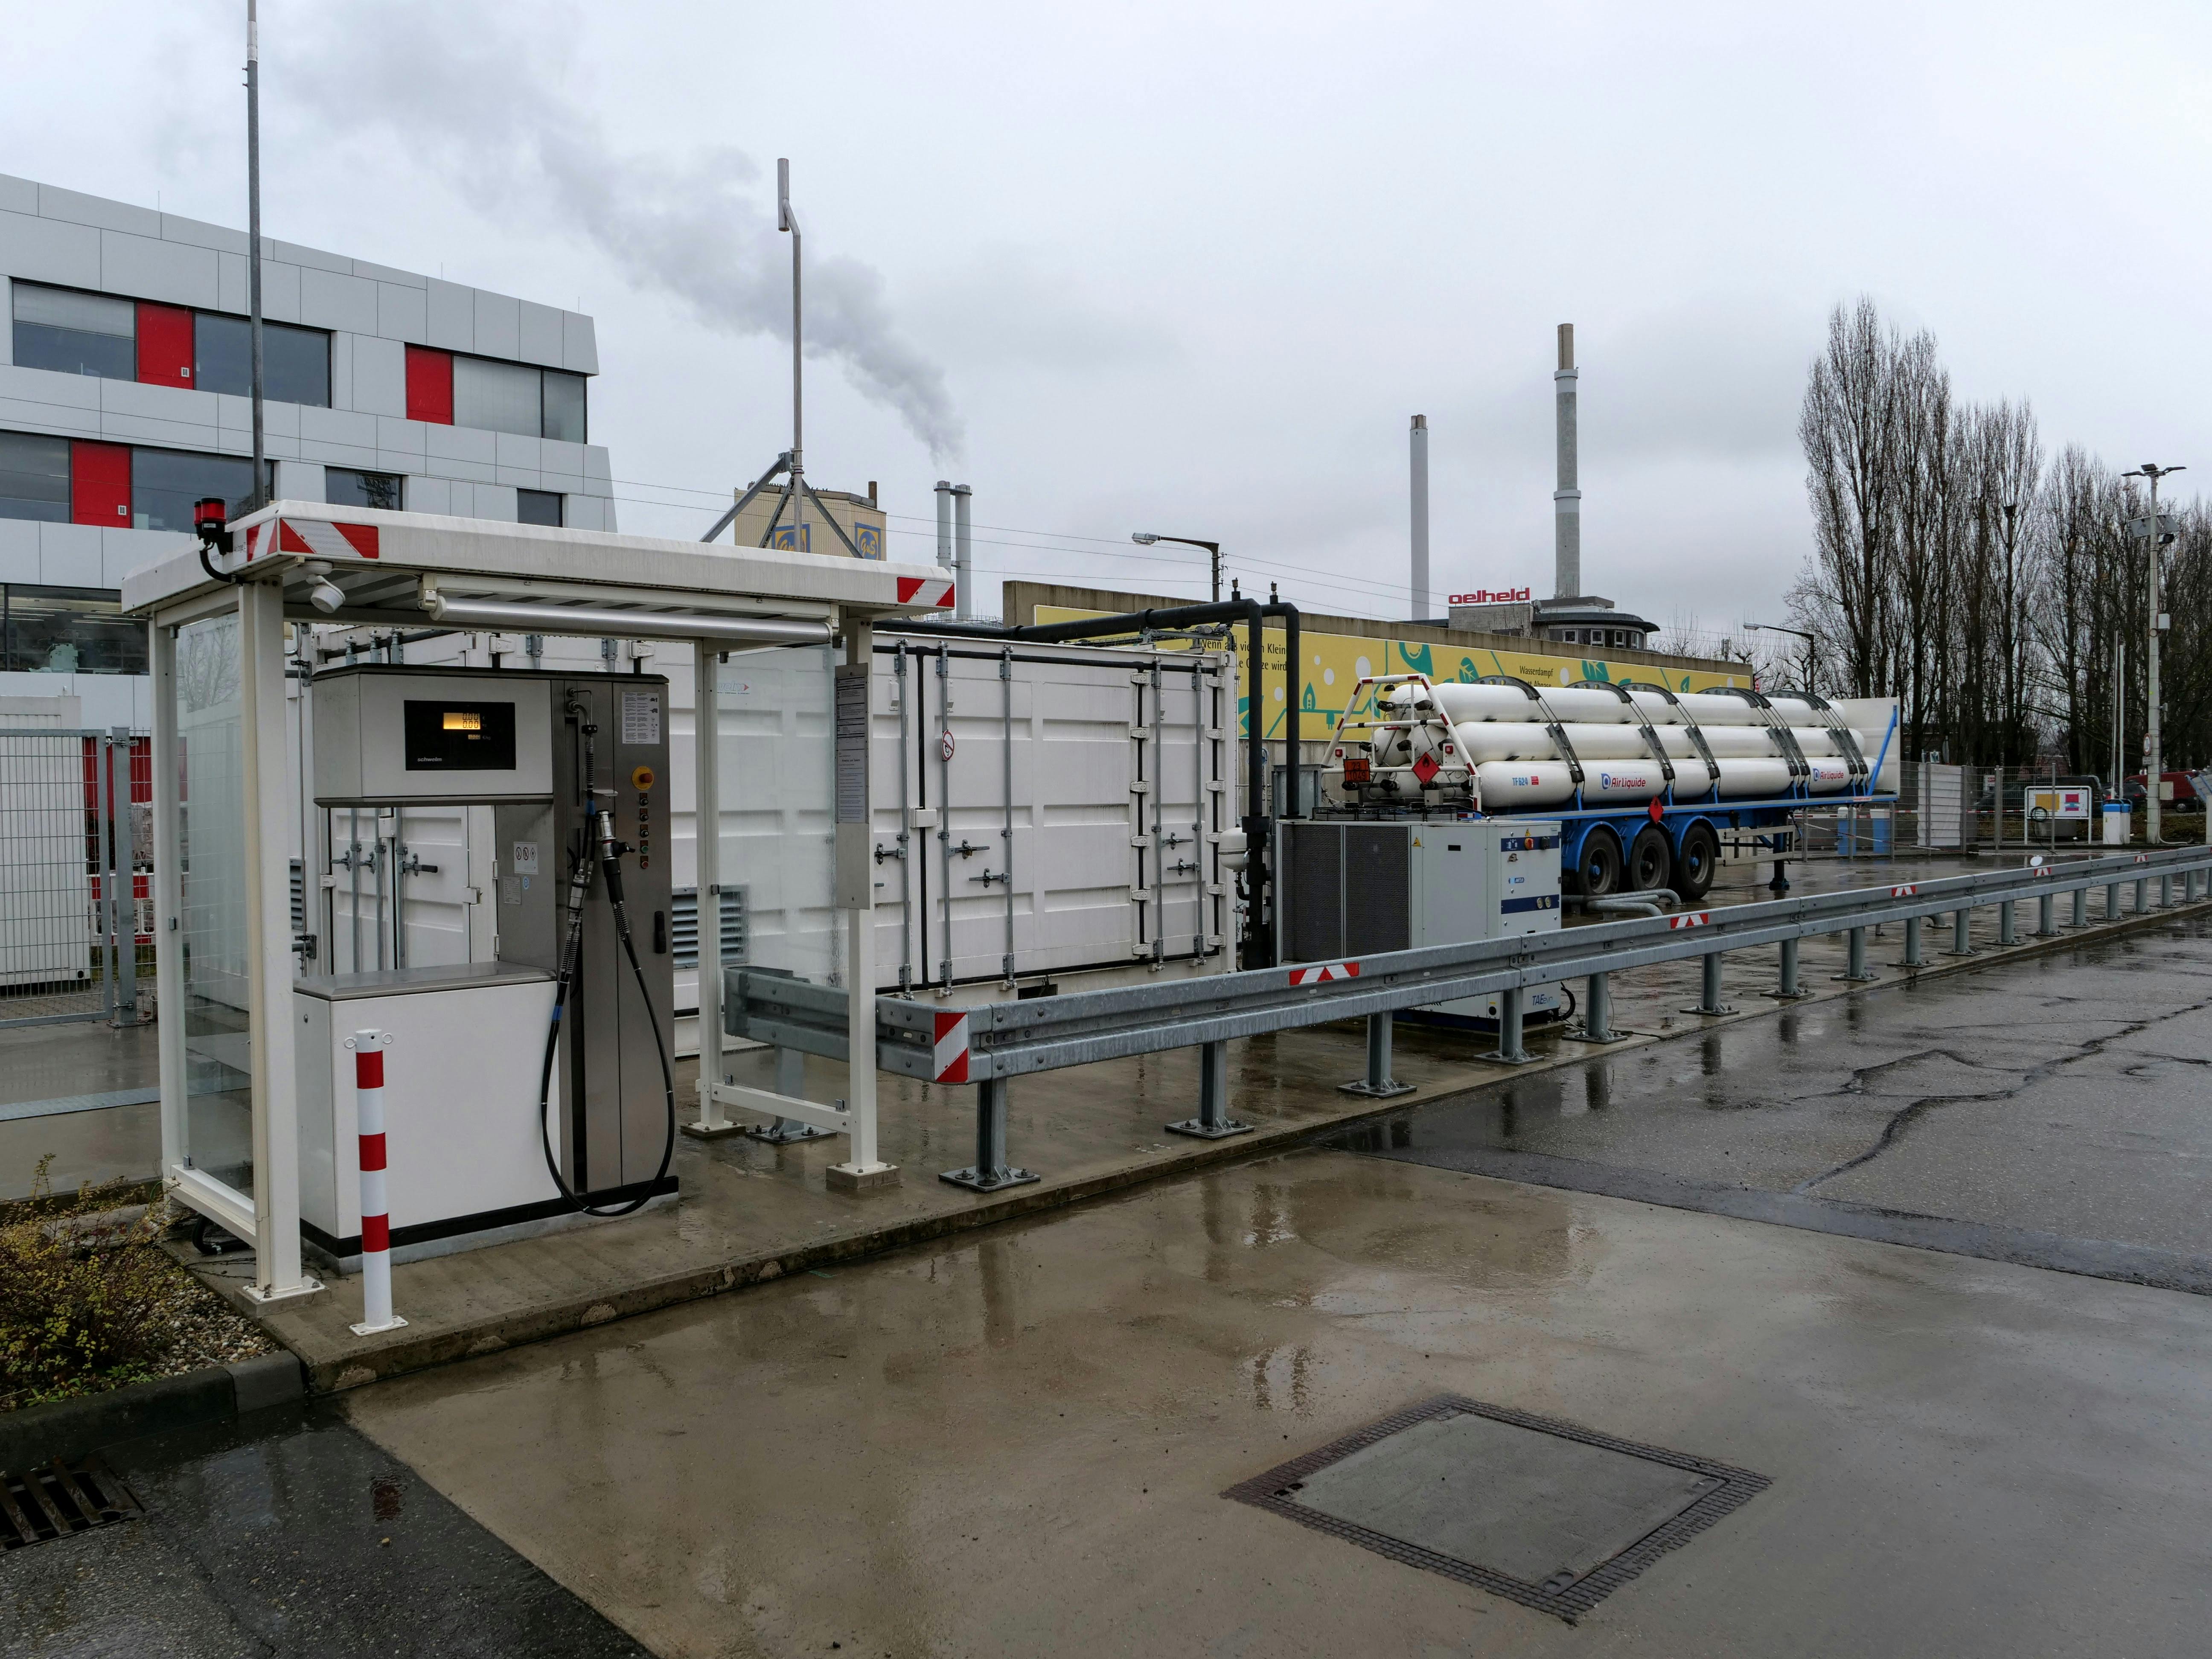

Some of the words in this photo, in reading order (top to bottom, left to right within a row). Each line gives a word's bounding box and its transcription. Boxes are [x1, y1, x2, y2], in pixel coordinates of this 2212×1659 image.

[1449, 587, 1530, 604] oelheld
[1199, 639, 1222, 649] Wenn
[1240, 641, 1264, 653] vien
[1272, 661, 1287, 671] wird
[1519, 665, 1553, 678] Wasserdampf
[1352, 762, 1361, 770] 23
[1349, 771, 1366, 780] 1049
